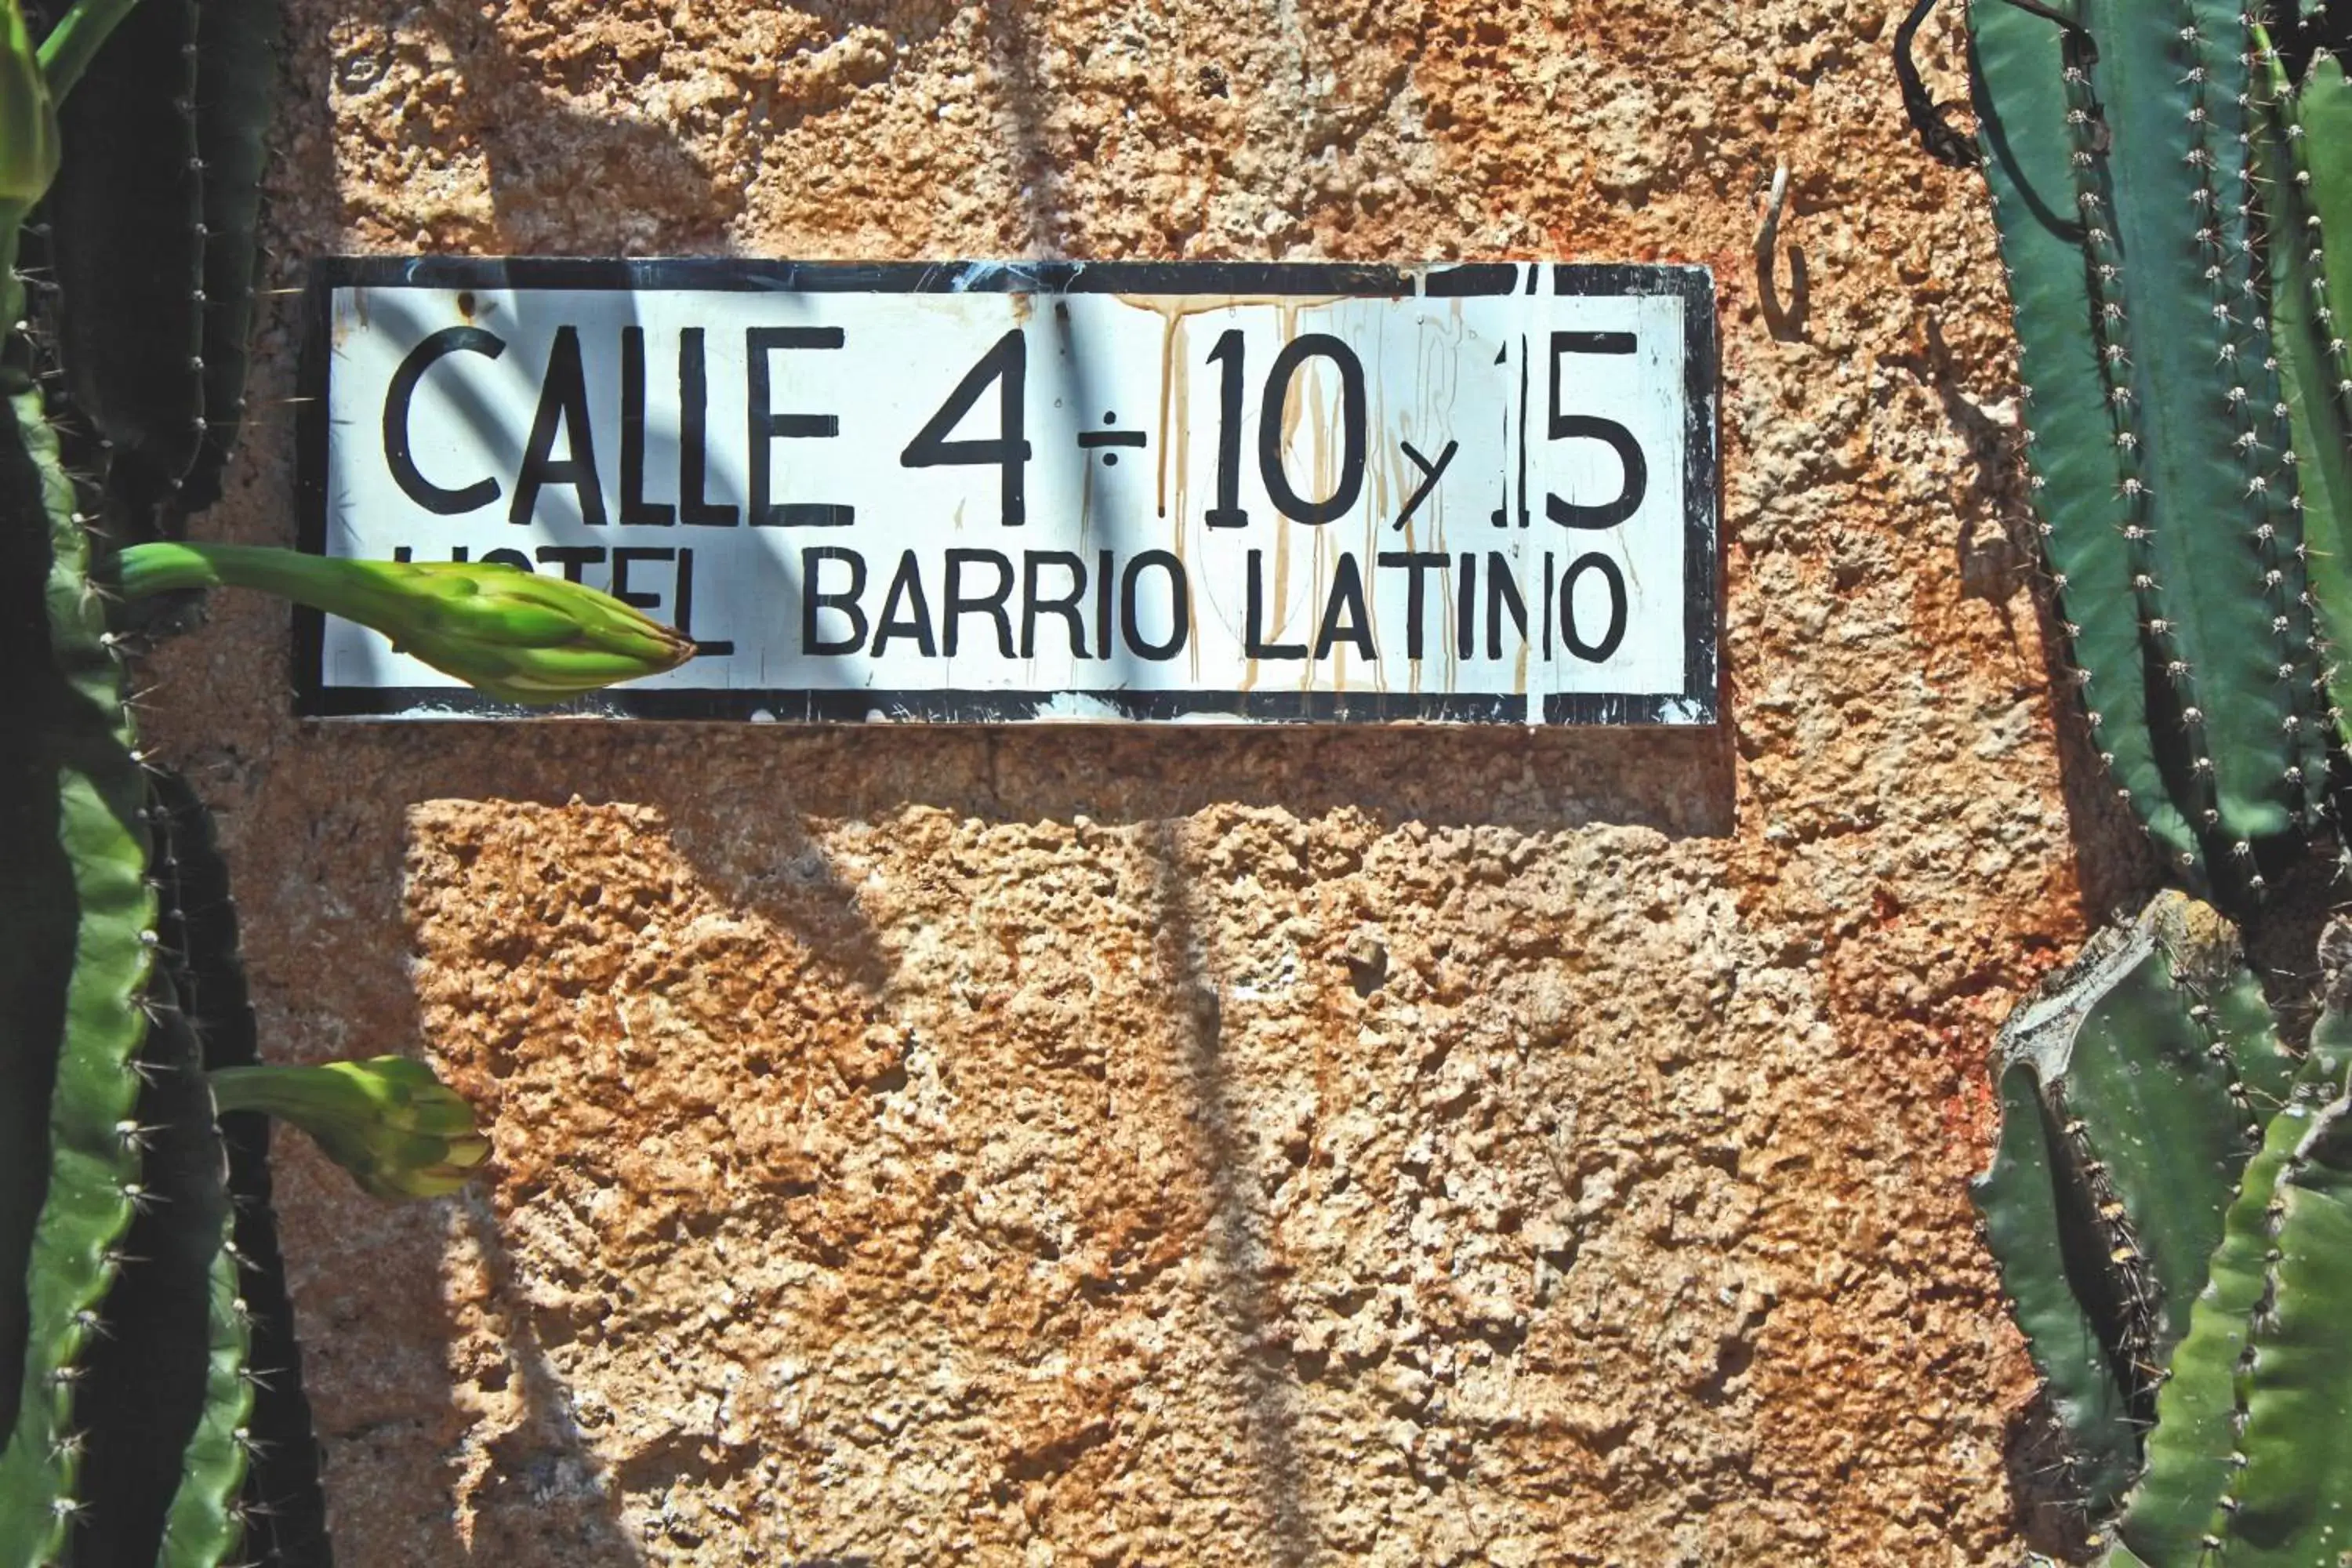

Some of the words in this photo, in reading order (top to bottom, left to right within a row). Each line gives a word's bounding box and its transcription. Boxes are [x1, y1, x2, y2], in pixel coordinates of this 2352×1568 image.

[383, 325, 855, 527] CALLE
[900, 327, 1032, 527] 4
[1205, 328, 1367, 528] 10
[1395, 440, 1458, 531] y
[802, 546, 1189, 661] BARRIO
[1245, 550, 1628, 663] LATINO
